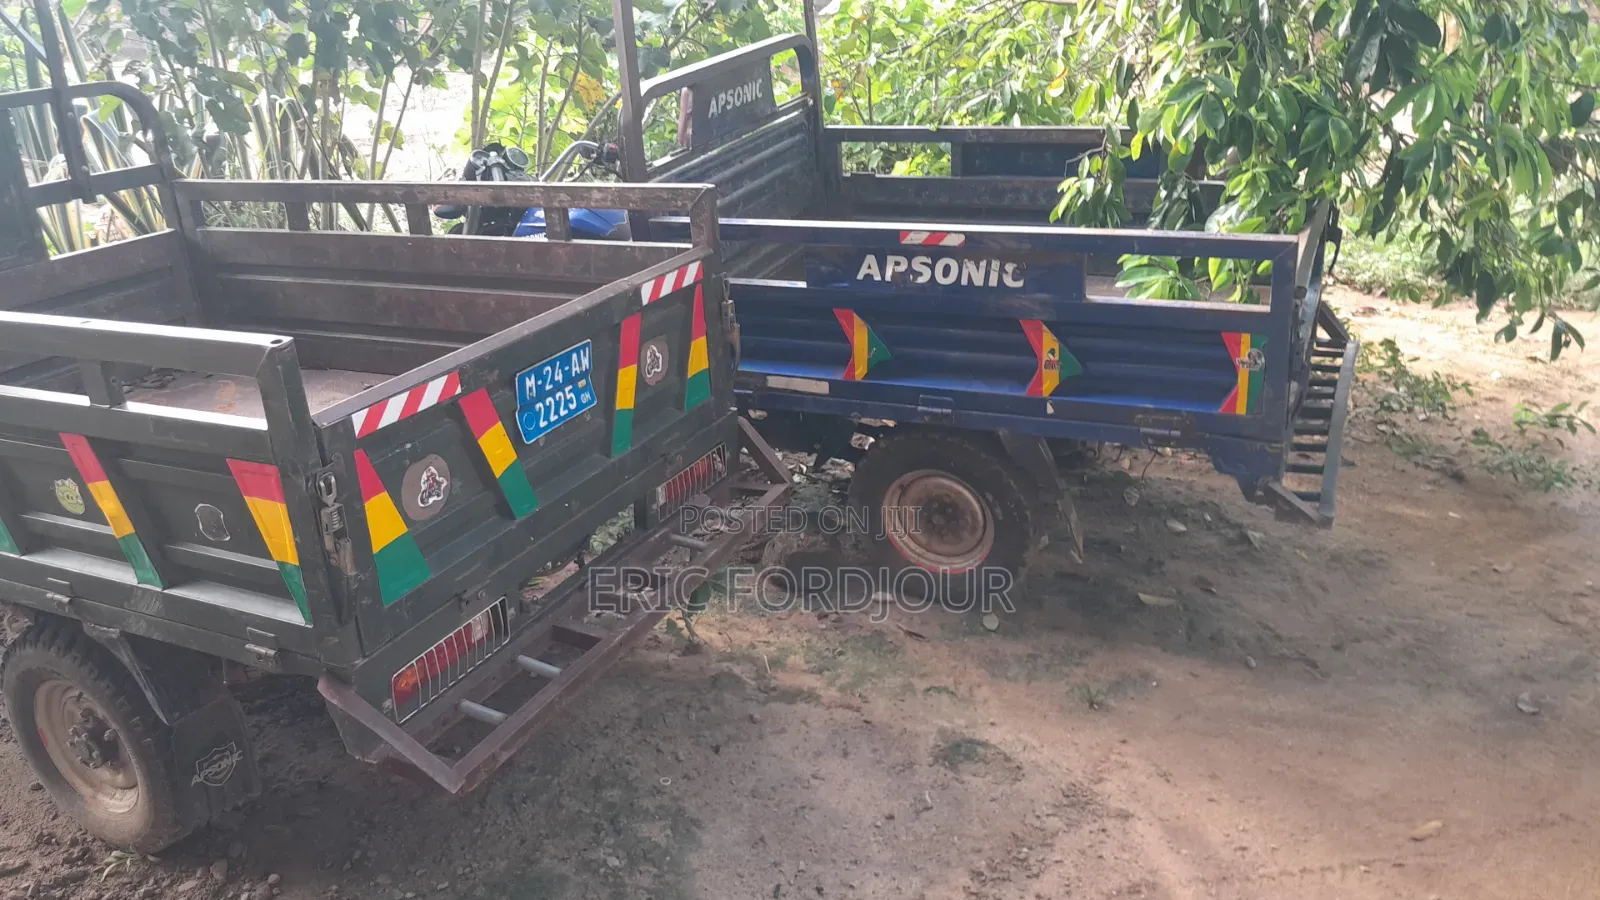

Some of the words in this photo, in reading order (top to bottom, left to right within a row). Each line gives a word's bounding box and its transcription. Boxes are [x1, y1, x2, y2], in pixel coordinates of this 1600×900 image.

[708, 78, 763, 118] APSONIC
[856, 254, 1026, 288] APSONIC
[525, 346, 590, 400] M-24-AW
[535, 385, 577, 428] 2225
